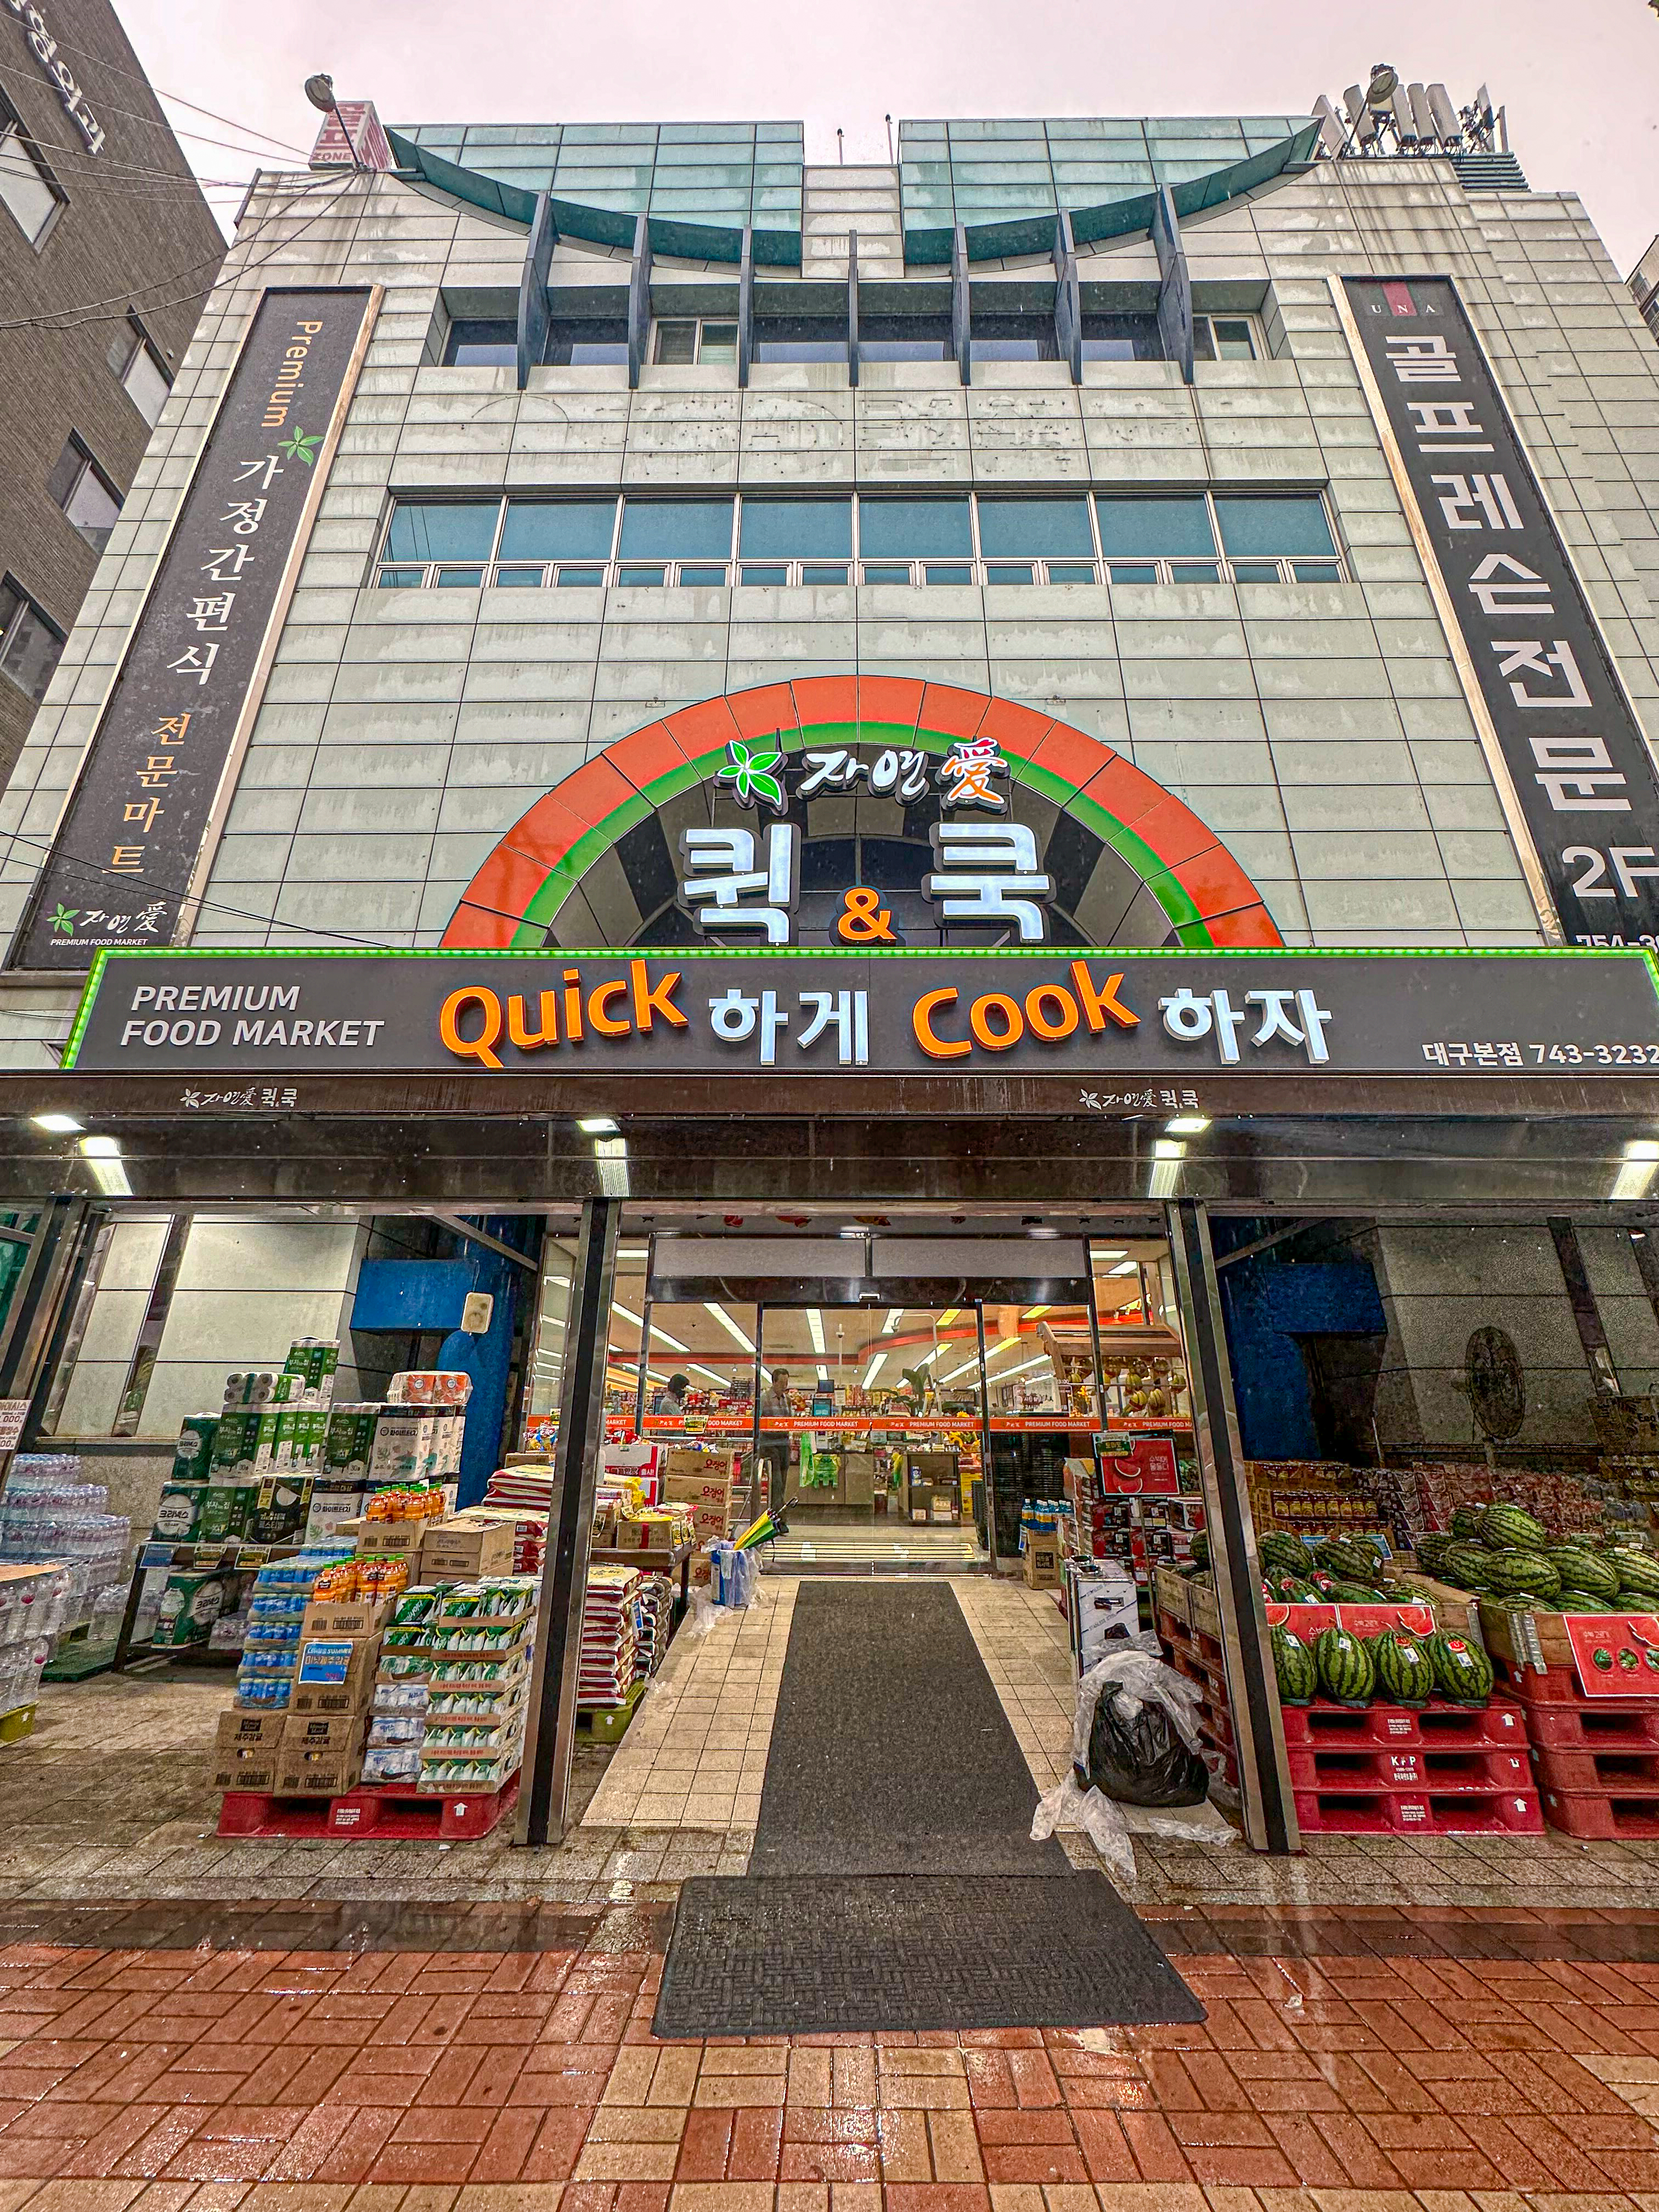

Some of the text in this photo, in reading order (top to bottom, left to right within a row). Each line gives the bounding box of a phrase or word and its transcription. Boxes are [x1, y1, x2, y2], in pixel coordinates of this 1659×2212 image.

[3, 0, 105, 154] 형외과
[261, 320, 324, 427] Premium
[166, 454, 285, 686] 가정간편식
[102, 712, 192, 874] 전문마트
[684, 823, 1050, 945] 퀵 & 쿡
[1561, 845, 1659, 898] 2F
[131, 985, 301, 1011] PREMIUM
[439, 958, 1333, 1069] Quick 하게 Cook 하자
[120, 1019, 385, 1047] FOOD MARKET
[1421, 1042, 1524, 1066] 대구본점
[703, 1459, 727, 1470] 오징어
[701, 1486, 725, 1498] 오징어
[159, 1510, 189, 1519] 크리넥스
[700, 1513, 724, 1525] 오징어
[692, 1567, 712, 1581] 오징
